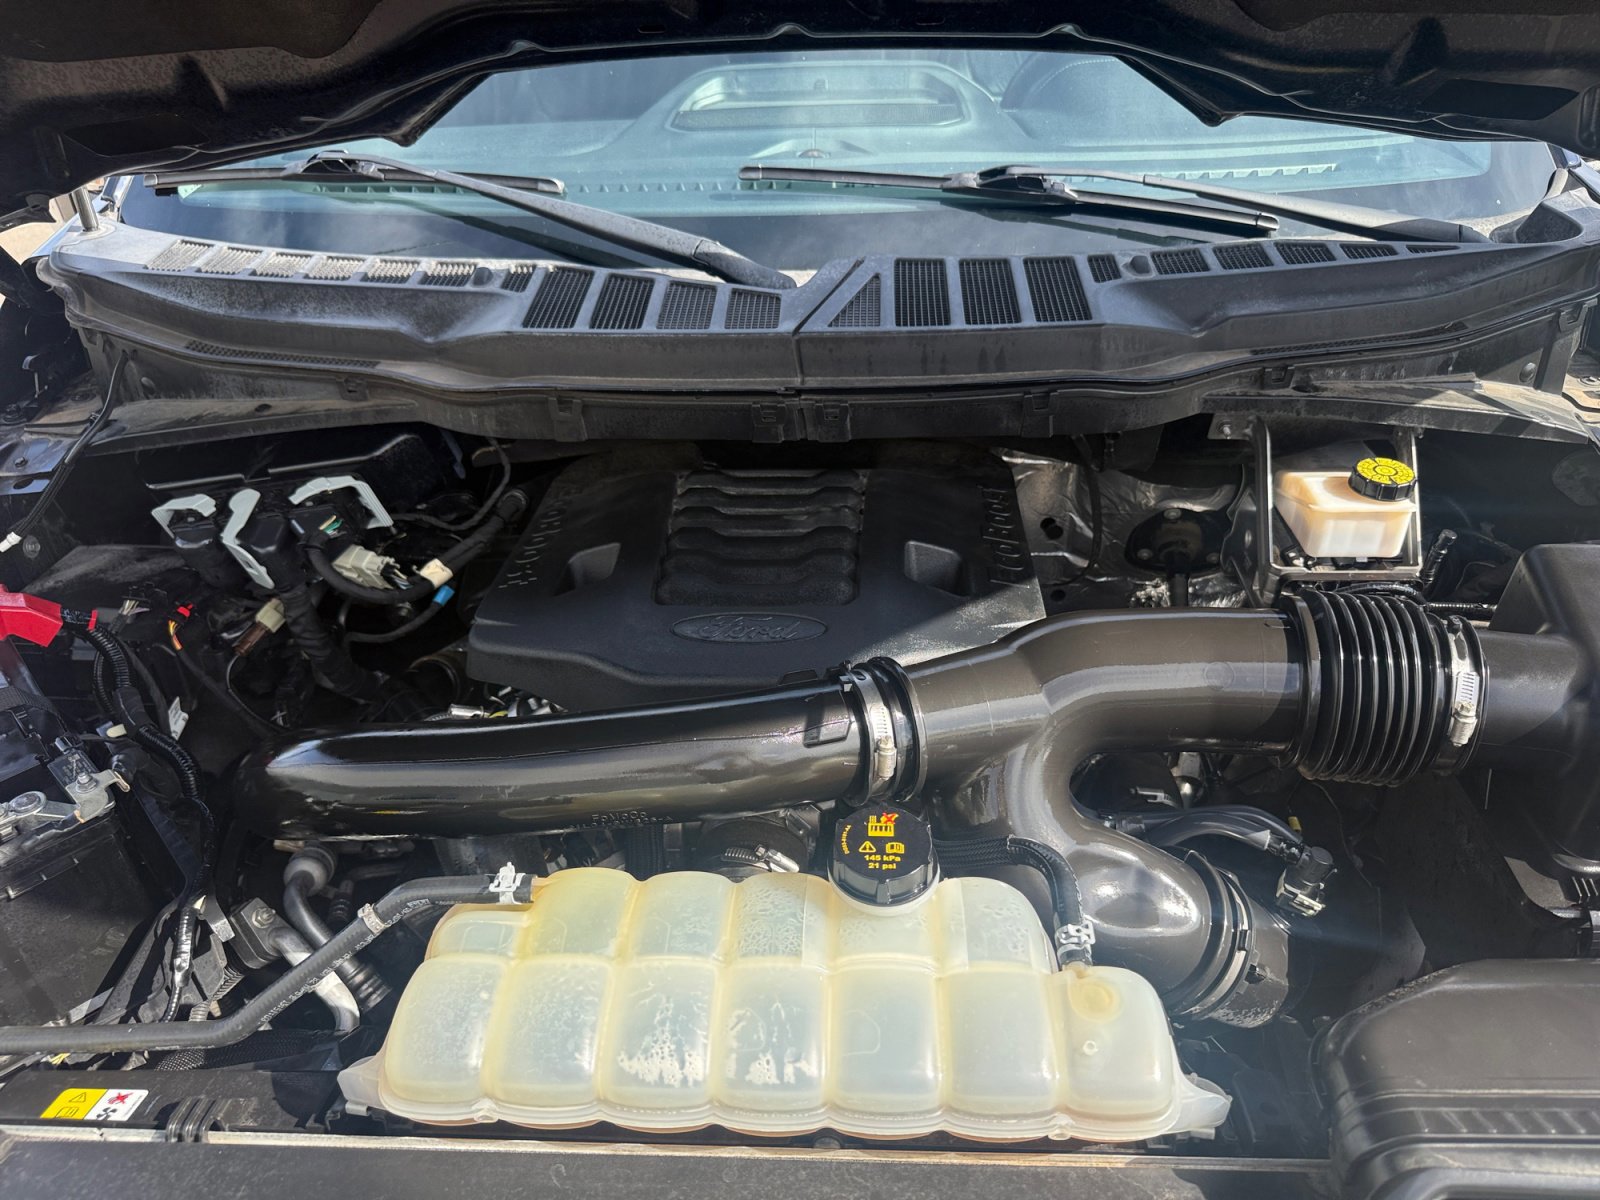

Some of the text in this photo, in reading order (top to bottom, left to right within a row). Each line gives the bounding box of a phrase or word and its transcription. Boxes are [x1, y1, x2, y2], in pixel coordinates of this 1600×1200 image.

[699, 615, 802, 640] Ford
[883, 854, 901, 862] kPa
[882, 863, 896, 871] psi
